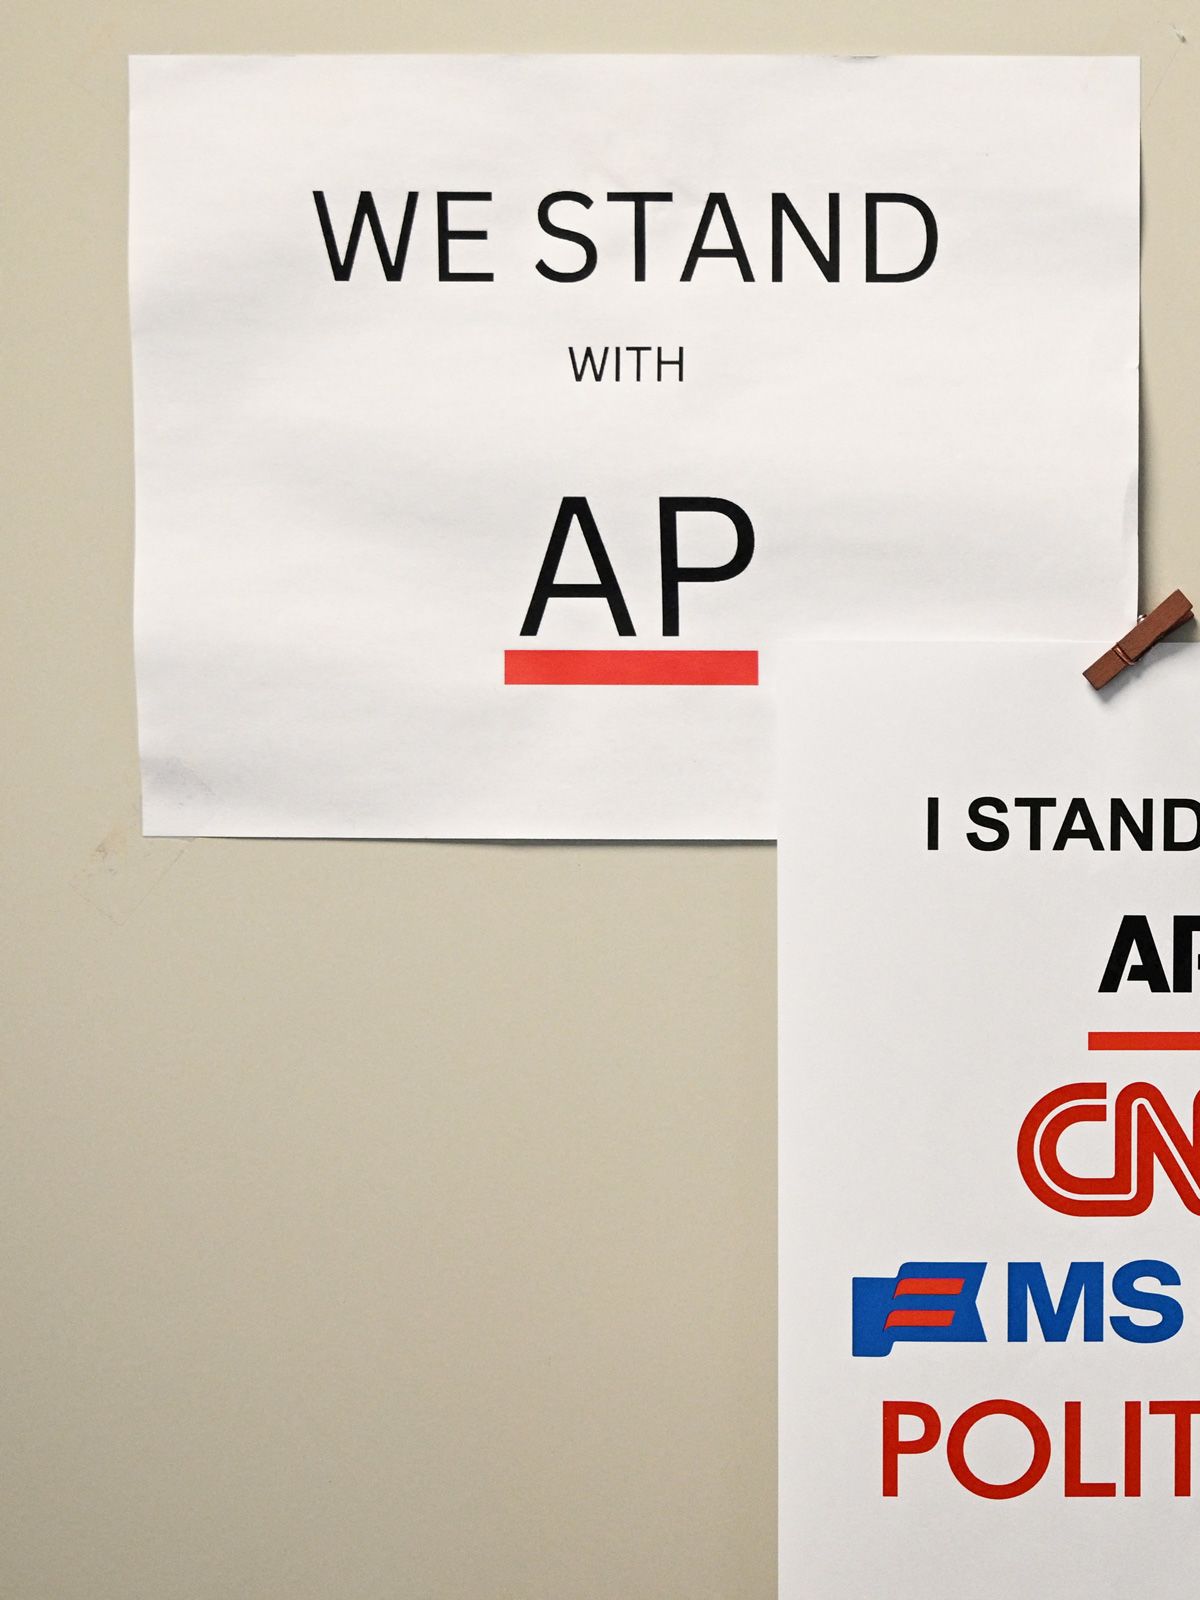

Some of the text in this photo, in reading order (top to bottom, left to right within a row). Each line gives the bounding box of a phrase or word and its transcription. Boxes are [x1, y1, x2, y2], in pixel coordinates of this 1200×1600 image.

[312, 190, 939, 284] WE STAND
[568, 346, 684, 382] WITH
[520, 496, 756, 637] AP
[927, 797, 939, 851] I
[1007, 1259, 1184, 1344] MS
